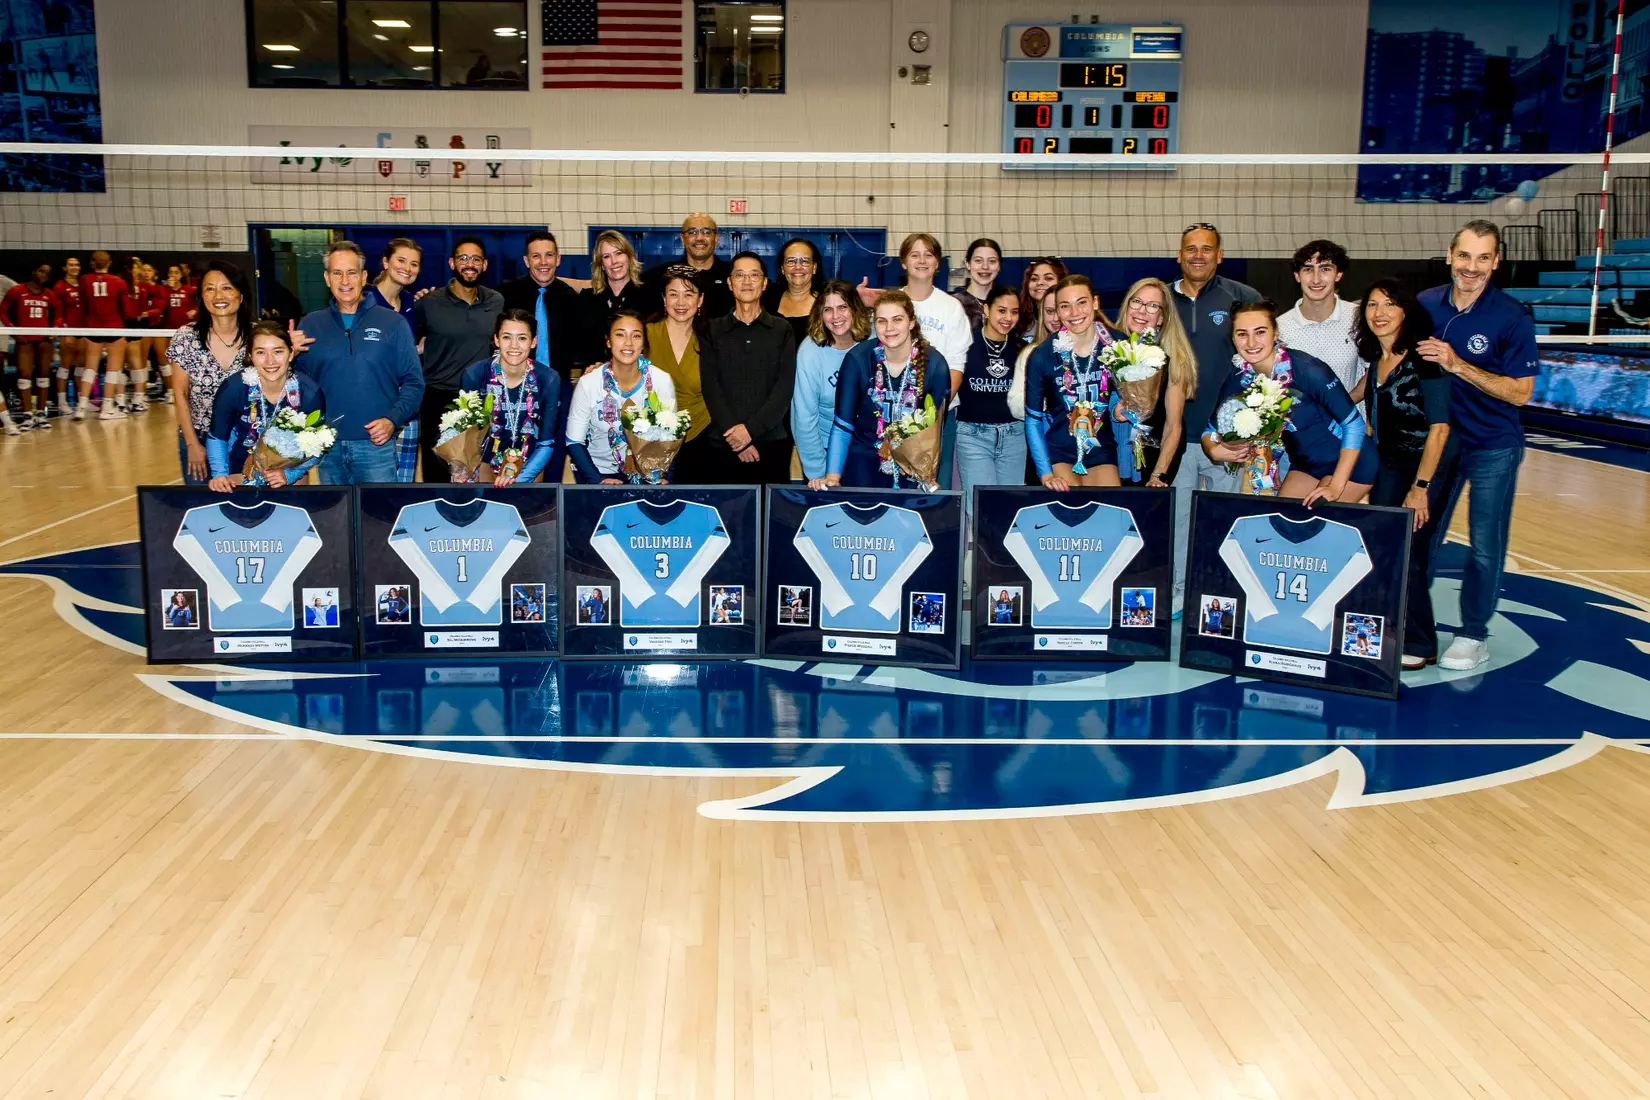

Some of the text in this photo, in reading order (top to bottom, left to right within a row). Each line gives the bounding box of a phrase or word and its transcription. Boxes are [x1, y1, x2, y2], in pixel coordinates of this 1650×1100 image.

[1067, 32, 1125, 40] COLUMBIA
[1084, 64, 1124, 86] 1:15
[1036, 105, 1050, 127] 0
[1092, 109, 1096, 124] 1
[1153, 106, 1167, 128] 0
[1046, 139, 1056, 154] 2
[1124, 139, 1134, 154] 2
[452, 162, 465, 178] P
[486, 163, 502, 178] Y
[92, 282, 108, 296] 11
[969, 377, 1012, 386] COLUMB
[970, 384, 1011, 392] UNIVERS
[215, 540, 284, 553] COLUMBIA
[429, 538, 494, 553] COLUMBIA
[630, 535, 692, 549] COLUMBIA
[832, 535, 896, 551] COLUMBIA
[1038, 537, 1102, 552] COLUMBIA
[456, 556, 468, 582] 1
[654, 552, 670, 579] 3
[850, 553, 877, 581] 10
[1058, 554, 1081, 581] 11
[1259, 552, 1328, 572] COLUMBIA
[236, 557, 265, 584] 17
[1275, 571, 1308, 602] 14
